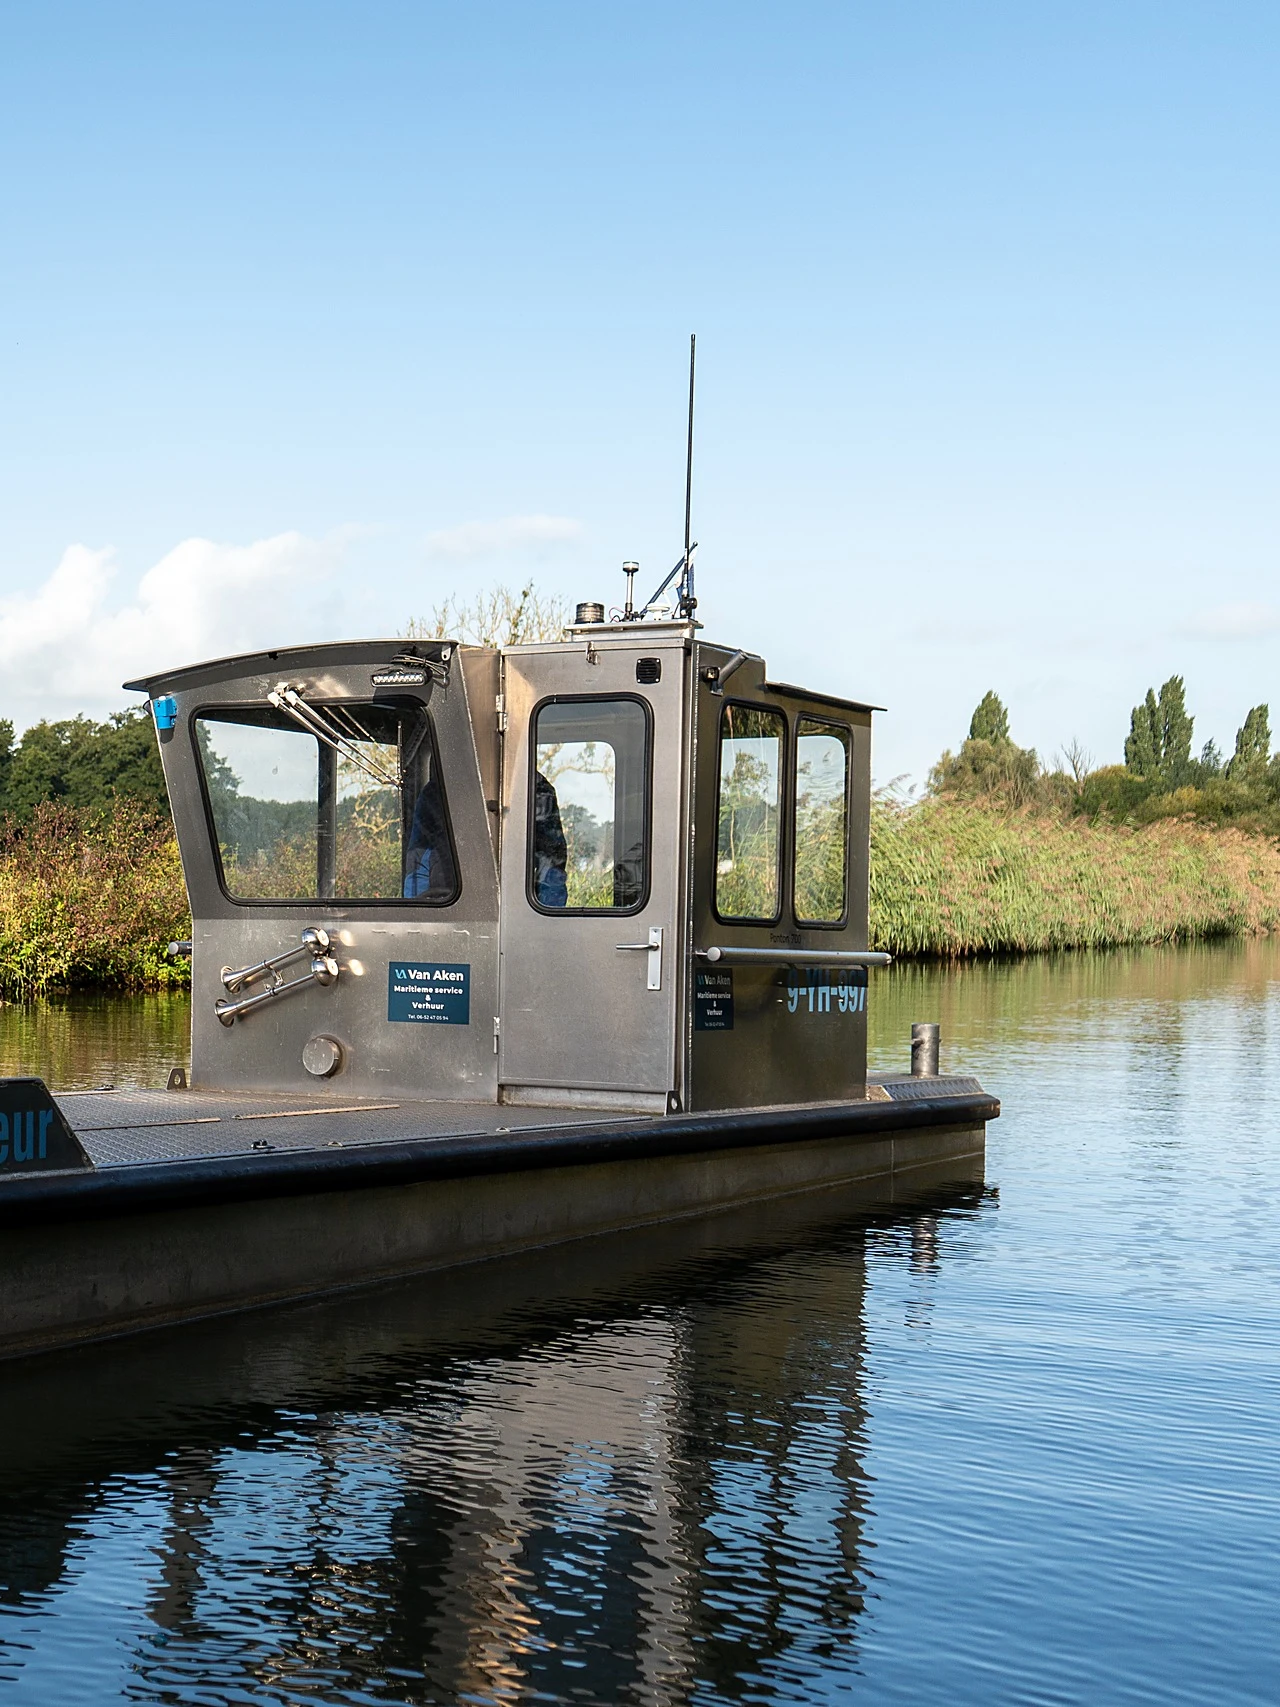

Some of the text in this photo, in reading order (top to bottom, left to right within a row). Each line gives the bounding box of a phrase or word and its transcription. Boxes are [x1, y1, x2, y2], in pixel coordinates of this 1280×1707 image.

[408, 969, 430, 980] Van
[433, 970, 464, 981] Aken
[704, 974, 731, 986] Van Aken
[394, 985, 463, 995] Maritieme service
[787, 968, 867, 1013] 9-YH-997
[412, 1002, 445, 1010] Verhuur
